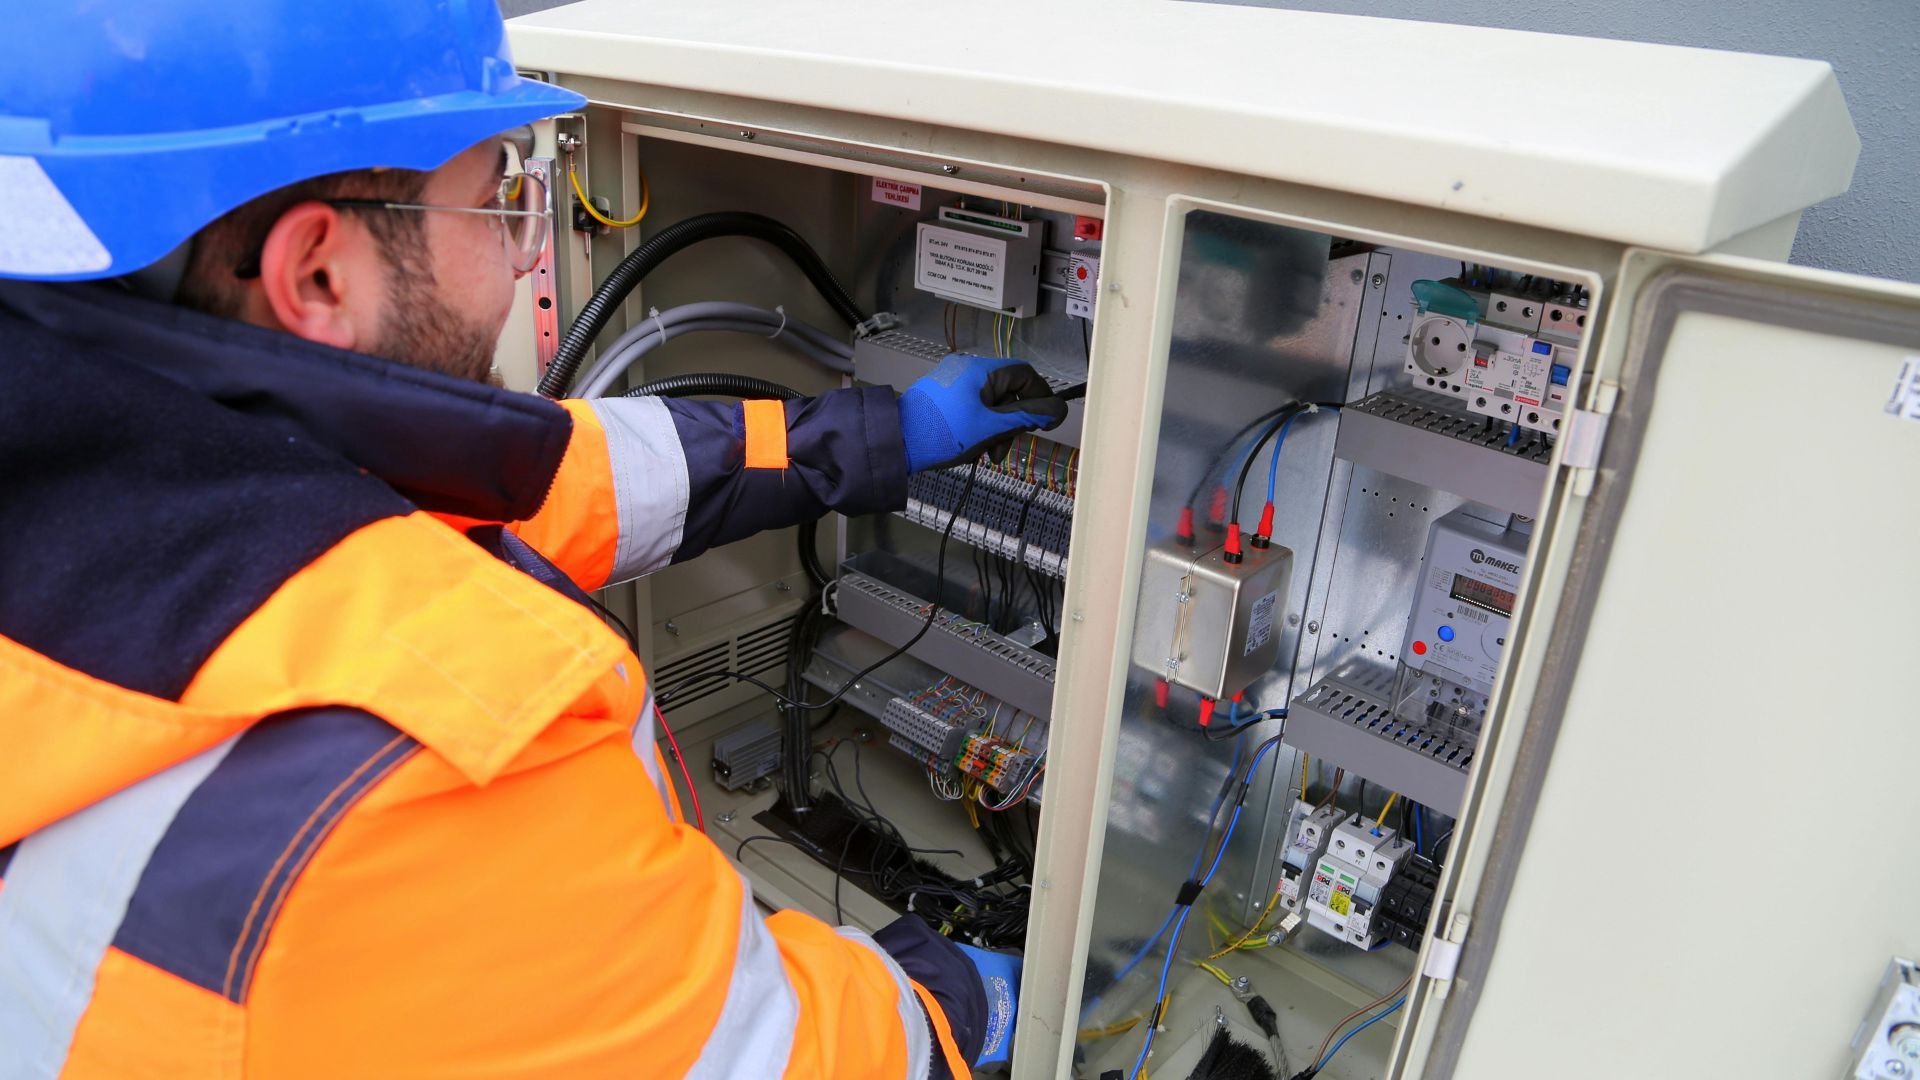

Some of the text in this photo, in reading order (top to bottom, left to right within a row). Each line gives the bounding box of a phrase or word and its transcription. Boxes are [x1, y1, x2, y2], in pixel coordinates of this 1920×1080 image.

[876, 180, 919, 196] ELEKTRİK ÇARPMA
[885, 192, 910, 203] TEHLİKESİ
[957, 257, 975, 267] KORUMA
